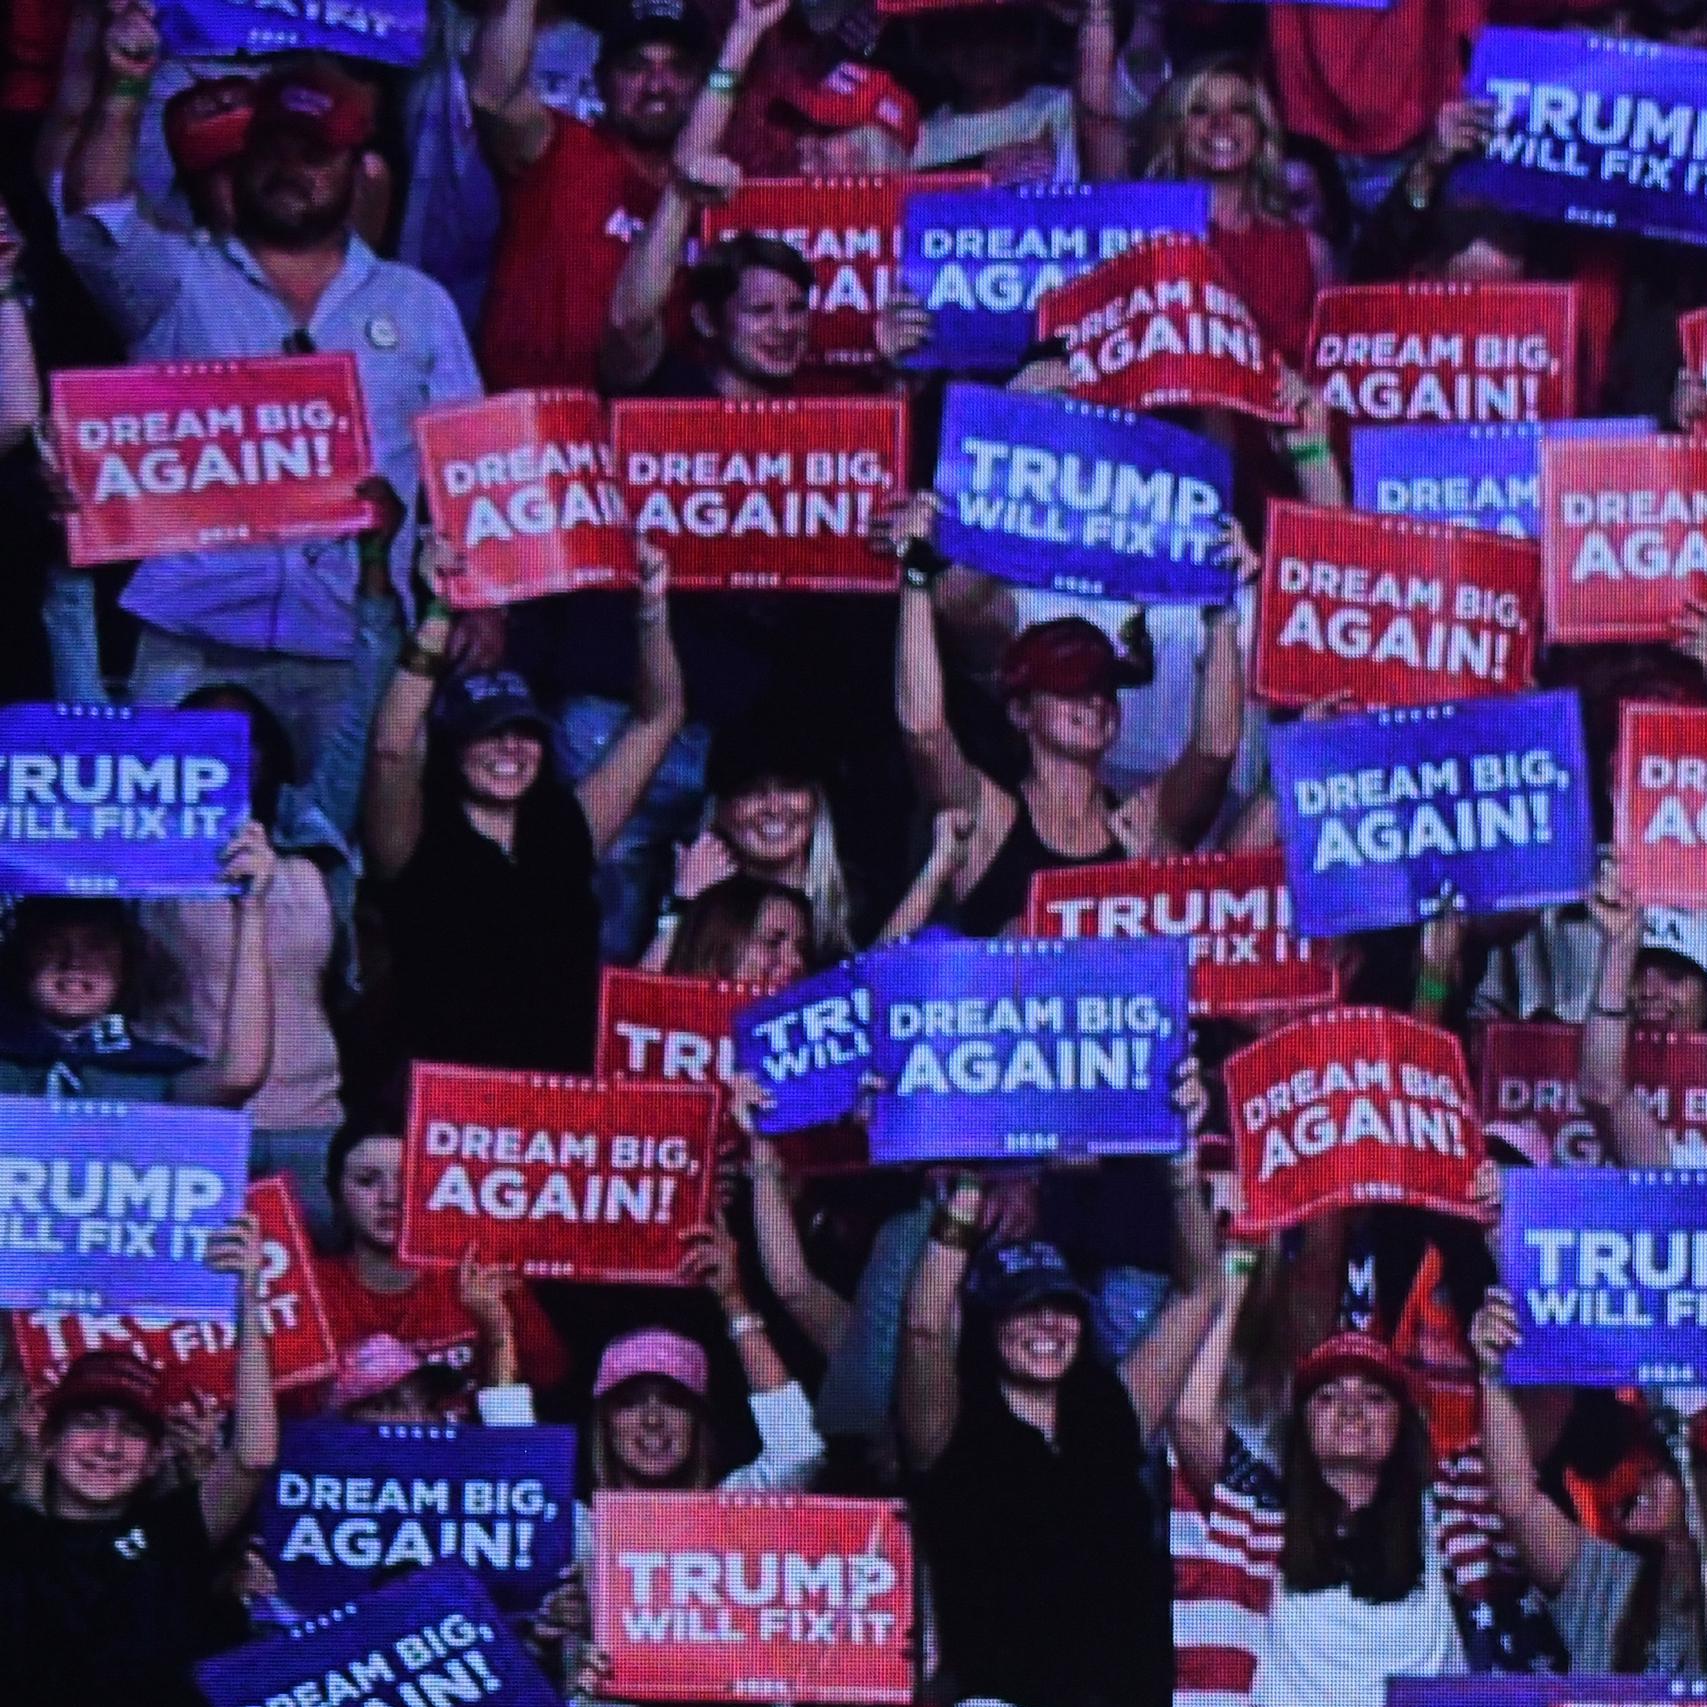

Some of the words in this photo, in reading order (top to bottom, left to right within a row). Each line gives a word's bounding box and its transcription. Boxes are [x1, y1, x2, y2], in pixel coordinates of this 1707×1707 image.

[1602, 149, 1671, 191] FIX
[1069, 317, 1263, 383] AGAIN!
[1316, 335, 1463, 368] DREAM
[1323, 372, 1539, 421] AGAIN!
[77, 406, 242, 448] DREAM
[96, 437, 332, 500] AGAIN!
[627, 450, 789, 485] DREAM
[962, 437, 1219, 518] TRUMP
[634, 490, 871, 537] AGAIN!
[959, 491, 1067, 544] WILL
[1082, 514, 1155, 556] FIX
[1169, 526, 1211, 567] IT
[1280, 558, 1440, 611] DREAM
[1282, 601, 1508, 680] AGAIN!
[1295, 759, 1458, 817] DREAM
[92, 808, 168, 839] FIX
[182, 806, 226, 839] IT
[1313, 792, 1552, 873] AGAIN!
[889, 996, 1064, 1040] DREAM
[897, 1037, 1151, 1097] AGAIN!
[425, 1122, 596, 1168] DREAM
[1260, 1098, 1467, 1182] AGAIN!
[428, 1165, 677, 1225] AGAIN!
[78, 1217, 156, 1259] FIX
[1527, 1289, 1655, 1327] WILL
[278, 1472, 448, 1516] DREAM
[281, 1515, 534, 1570] AGAIN!
[615, 1550, 898, 1607] TRUMP
[617, 1608, 747, 1643] WILL
[759, 1609, 839, 1645] FIX
[851, 1609, 896, 1645] IT
